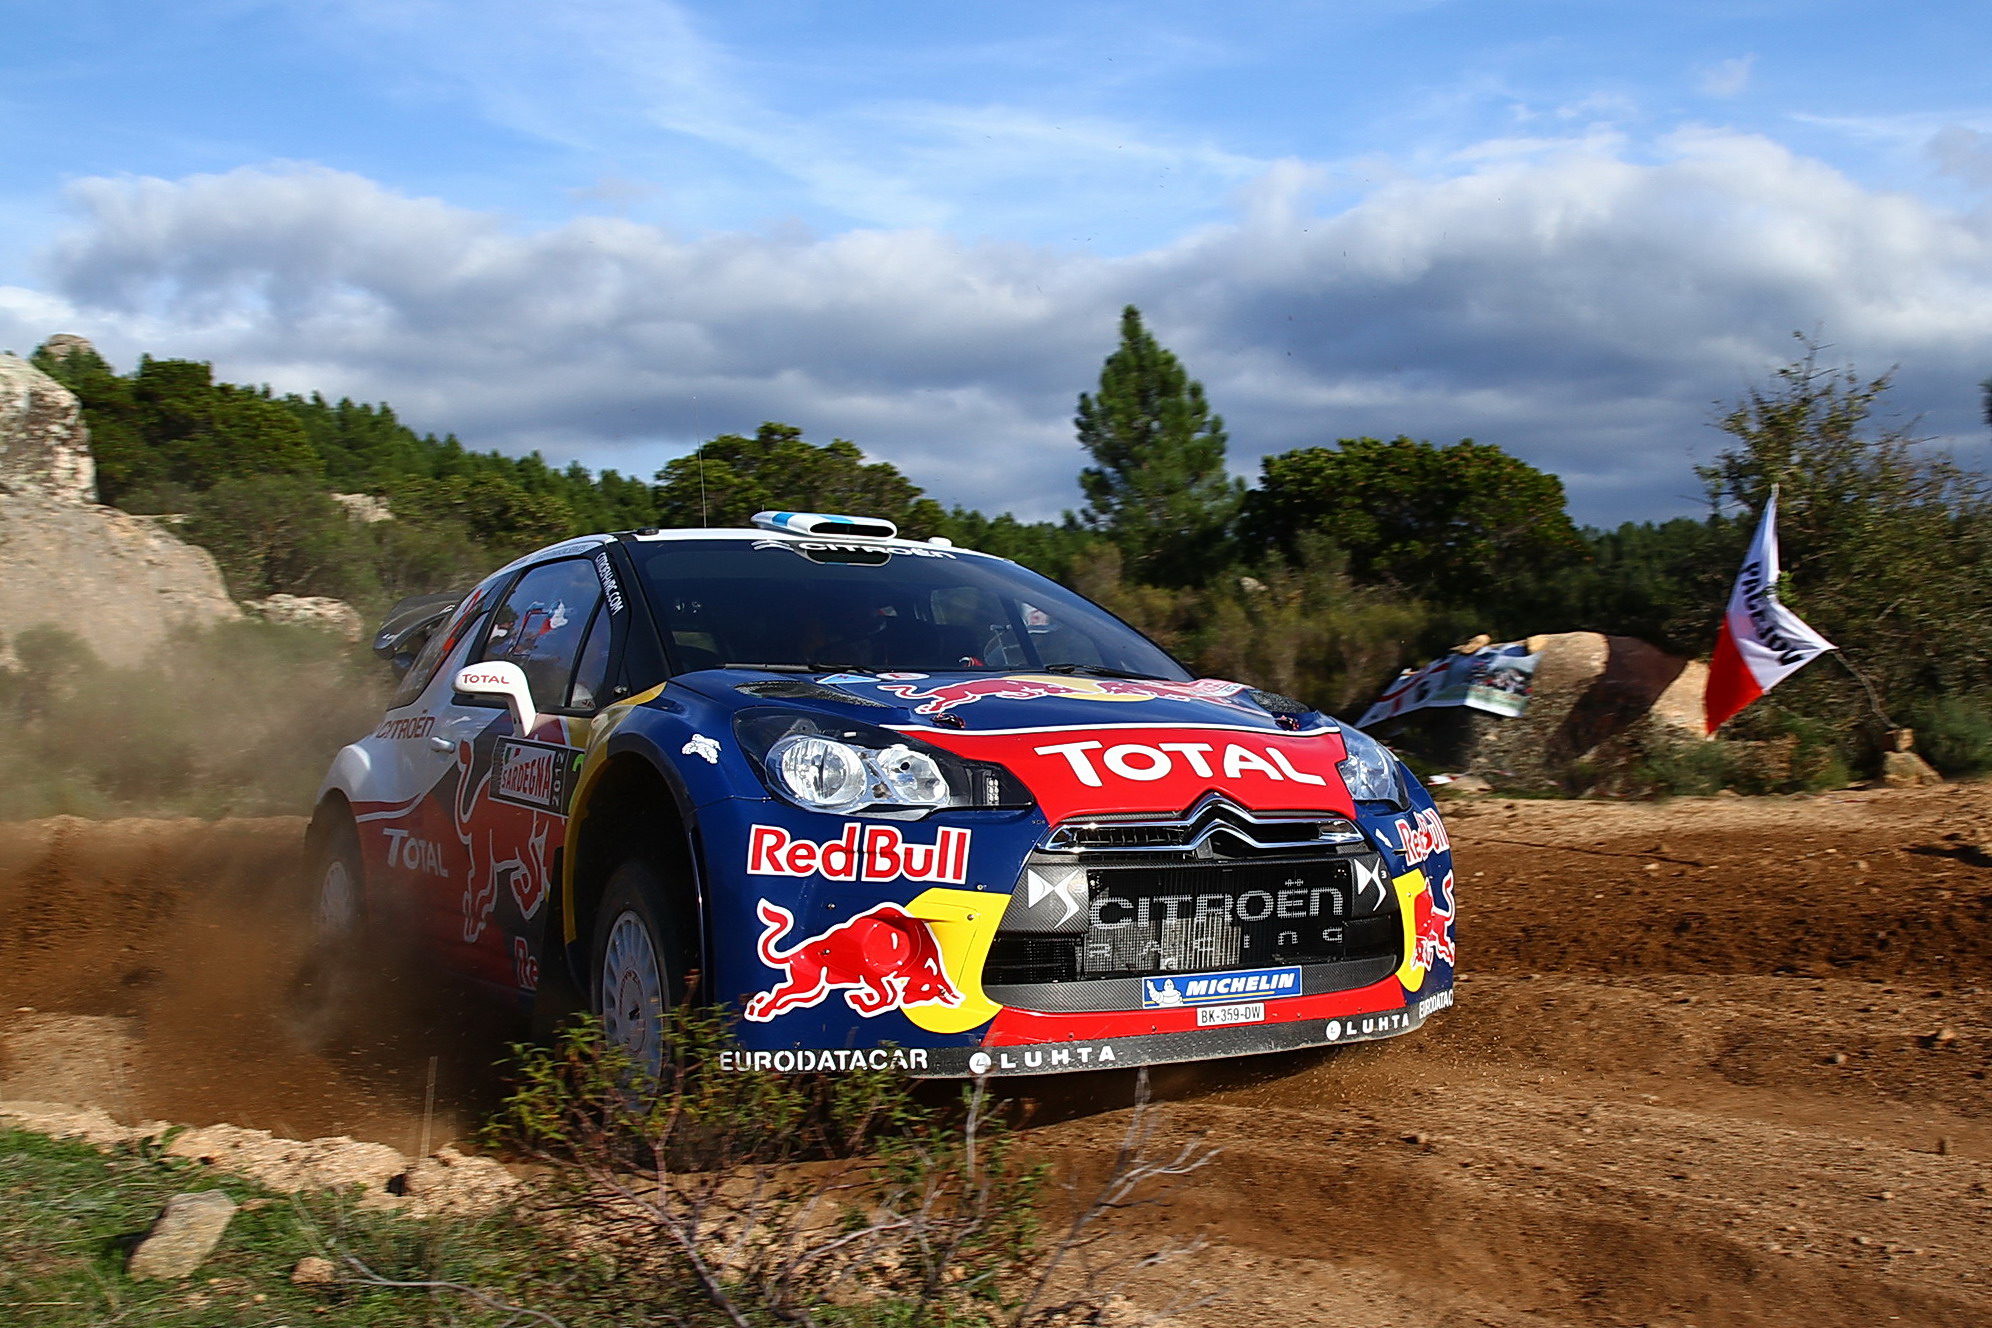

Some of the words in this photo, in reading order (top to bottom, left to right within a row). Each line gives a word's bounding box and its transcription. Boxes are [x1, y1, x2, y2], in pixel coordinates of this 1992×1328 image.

[461, 673, 511, 685] TOTAL
[501, 754, 552, 801] SARDEGNA
[551, 752, 566, 807] 2012
[1033, 739, 1328, 788] TOTAL
[382, 828, 449, 878] TOTAL
[749, 823, 860, 880] Red
[863, 827, 970, 882] Bull
[1088, 879, 1344, 930] CITROËN
[1185, 972, 1296, 997] MICHELIN
[1201, 1005, 1262, 1024] BK-359-DW
[1346, 1019, 1410, 1036] LUHTA
[720, 1048, 928, 1072] EURODATACAR
[1001, 1045, 1117, 1069] LUHTA
